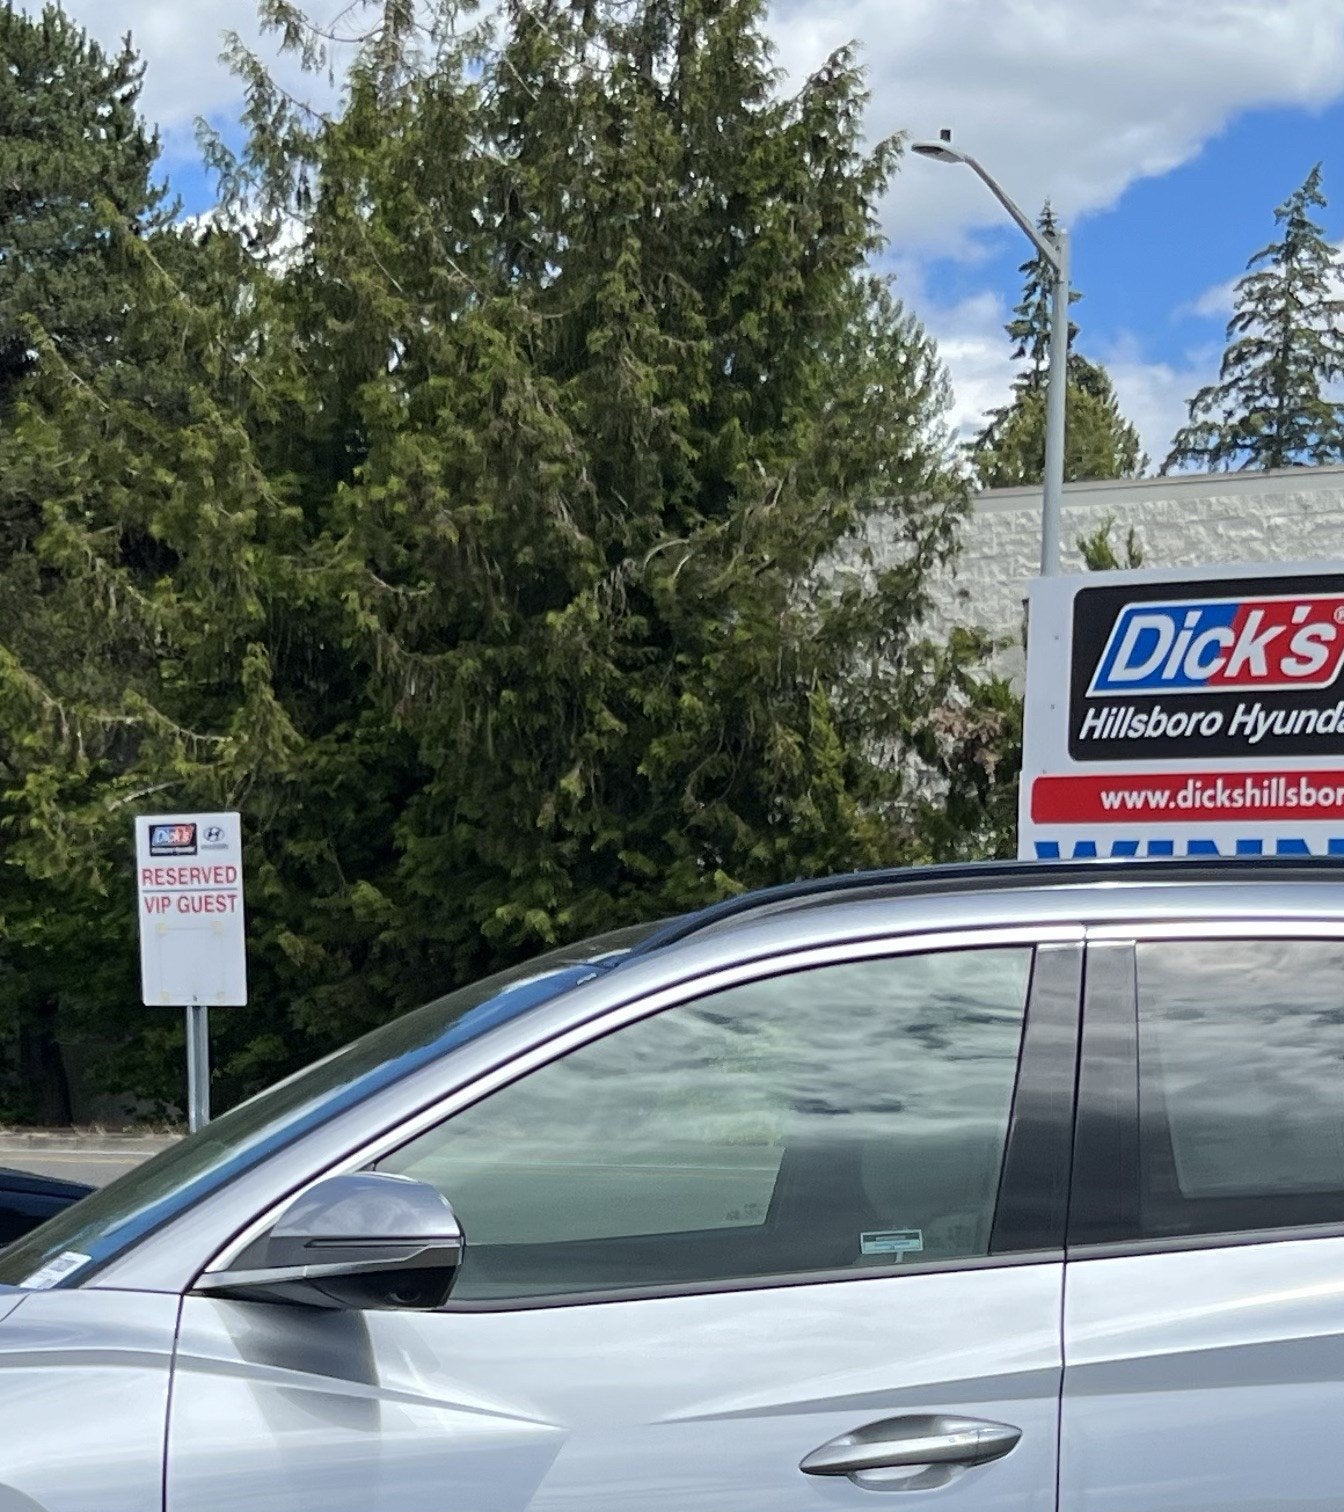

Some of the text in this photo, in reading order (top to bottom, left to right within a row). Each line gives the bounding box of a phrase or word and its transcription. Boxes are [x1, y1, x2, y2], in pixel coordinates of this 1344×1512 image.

[1078, 705, 1224, 740] Hillsboro
[142, 866, 238, 887] RESERVED
[144, 894, 238, 914] VIP GUEST
